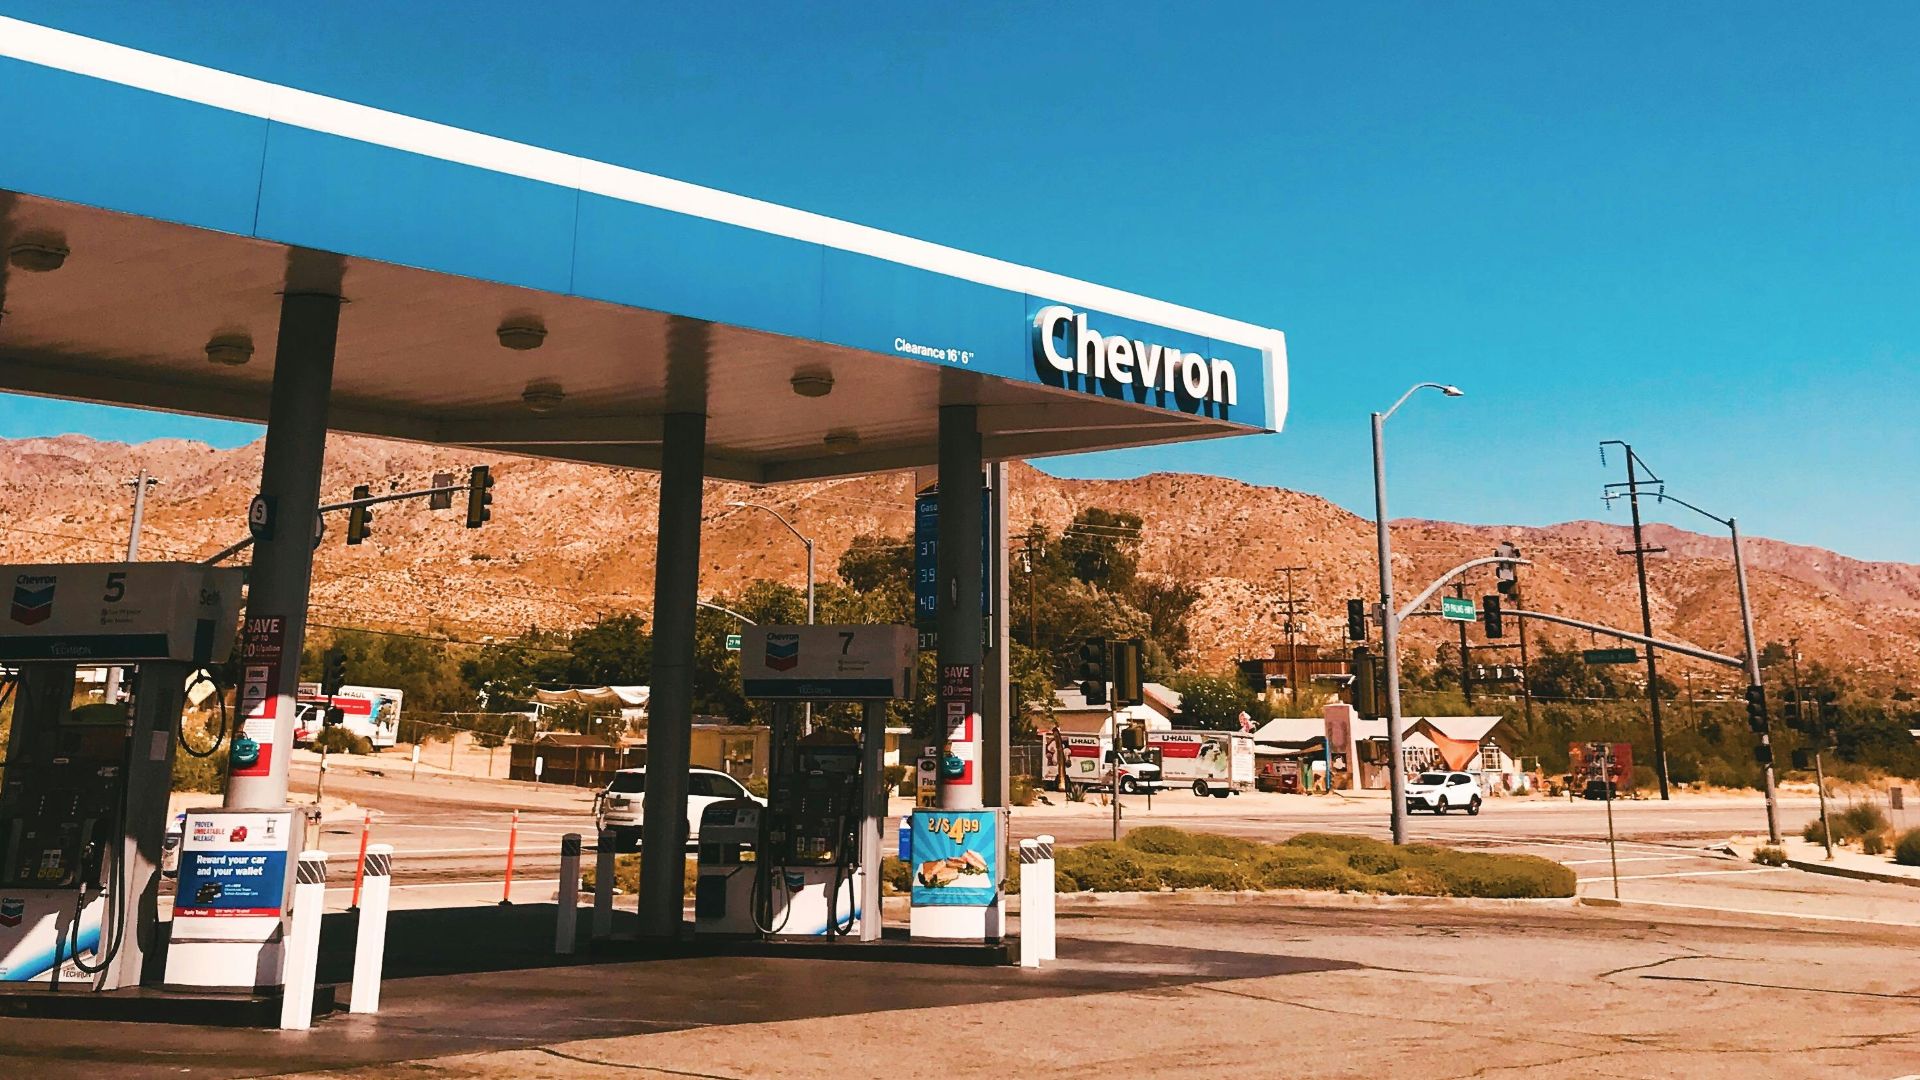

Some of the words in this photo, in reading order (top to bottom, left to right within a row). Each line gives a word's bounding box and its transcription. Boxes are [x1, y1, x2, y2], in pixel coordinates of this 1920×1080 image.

[894, 337, 945, 360] Clearance
[1035, 305, 1238, 406] Chevron
[920, 503, 938, 513] Gaso
[920, 541, 938, 556] 37
[920, 567, 937, 583] 39
[16, 574, 57, 584] Chevron
[103, 572, 127, 602] 5
[920, 595, 937, 611] 40
[247, 618, 280, 633] SAVE
[766, 632, 799, 641] Chevron
[838, 631, 854, 655] 7
[944, 666, 970, 678] SAVE
[942, 685, 954, 696] 20
[196, 854, 226, 865] Reward
[228, 855, 249, 866] your
[251, 856, 267, 865] car
[196, 866, 212, 876] and
[213, 868, 234, 878] your
[235, 866, 263, 876] wallet
